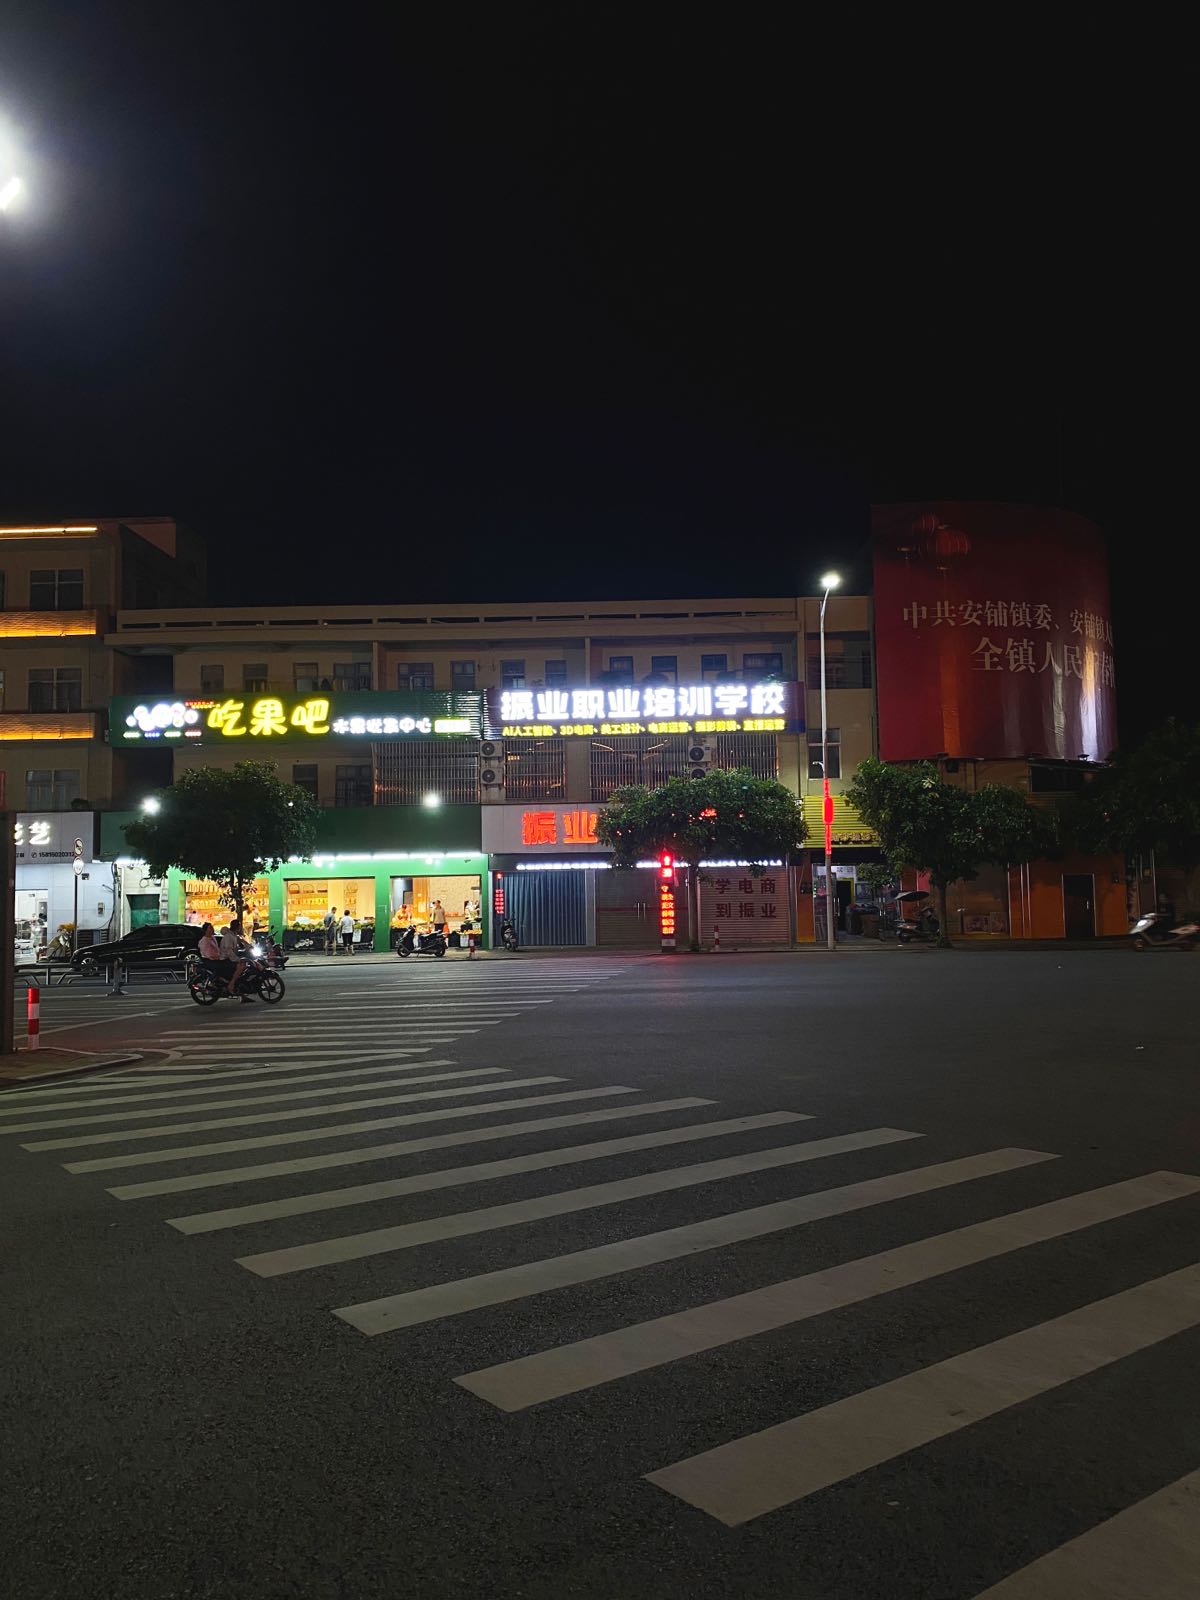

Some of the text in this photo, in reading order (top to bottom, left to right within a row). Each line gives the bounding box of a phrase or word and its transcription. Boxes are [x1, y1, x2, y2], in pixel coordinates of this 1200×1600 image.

[207, 699, 330, 736] 吃果吧
[500, 684, 786, 721] 振业职业培训学校
[522, 810, 599, 846] 振业
[715, 878, 777, 894] 学电商
[715, 903, 777, 919] 到振业
